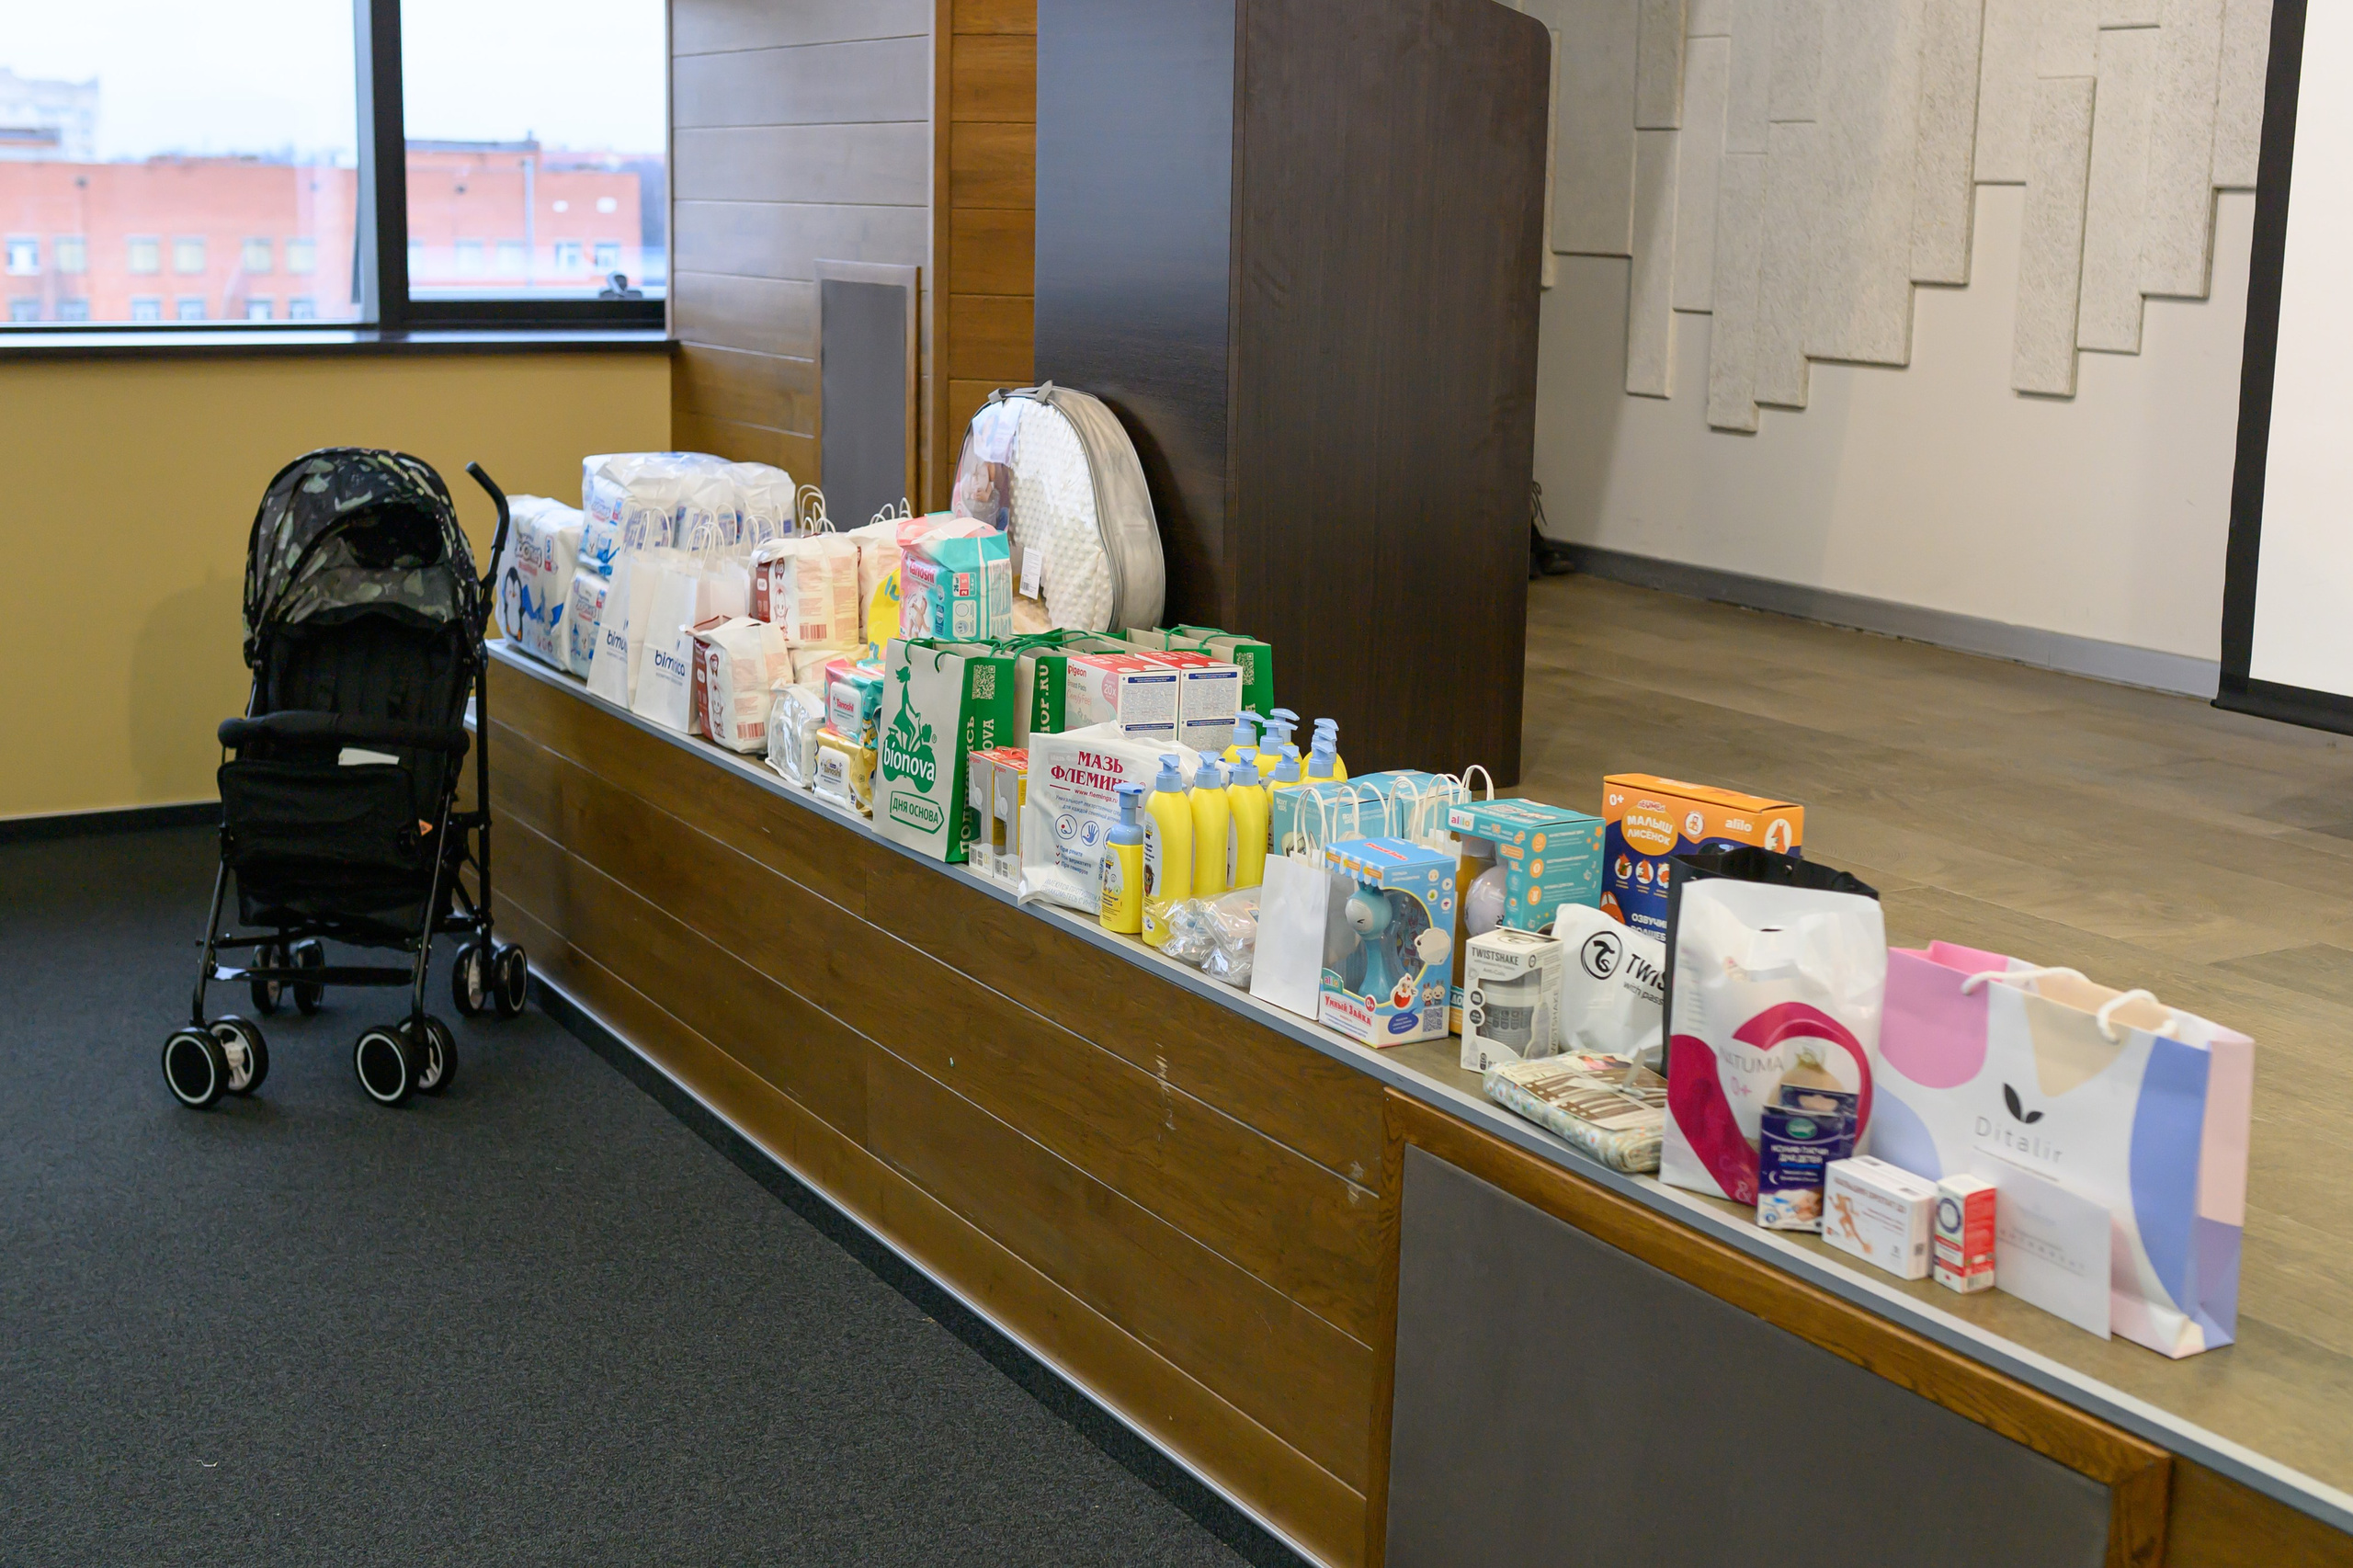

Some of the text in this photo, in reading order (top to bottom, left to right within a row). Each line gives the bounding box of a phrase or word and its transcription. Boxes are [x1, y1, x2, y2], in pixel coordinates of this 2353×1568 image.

[909, 558, 935, 584] Tanoshi
[1068, 664, 1086, 677] pigeon
[1104, 684, 1116, 697] 20x
[836, 699, 854, 712] Tanoshi
[883, 739, 935, 781] bionova
[1077, 750, 1123, 774] МАЗЬ
[824, 763, 842, 778] Tanoshi
[1051, 765, 1130, 793] ФЛЕМИН
[1074, 789, 1118, 803] www.fleminga.ru
[1609, 794, 1625, 806] 0+
[892, 798, 938, 824] ДНЯ ОСНОВА
[1450, 815, 1471, 827] alilo
[1627, 815, 1673, 835] МАЛЫШ
[1724, 818, 1753, 833] alilo
[1627, 828, 1671, 846] ЛИСЁНОК
[1472, 947, 1519, 966] TWISTSHAKE
[1623, 982, 1642, 995] with
[1324, 995, 1347, 1012] Умный
[1349, 1002, 1371, 1028] Зайка
[1731, 1075, 1753, 1096] 0+
[1975, 1116, 2063, 1164] Ditalir
